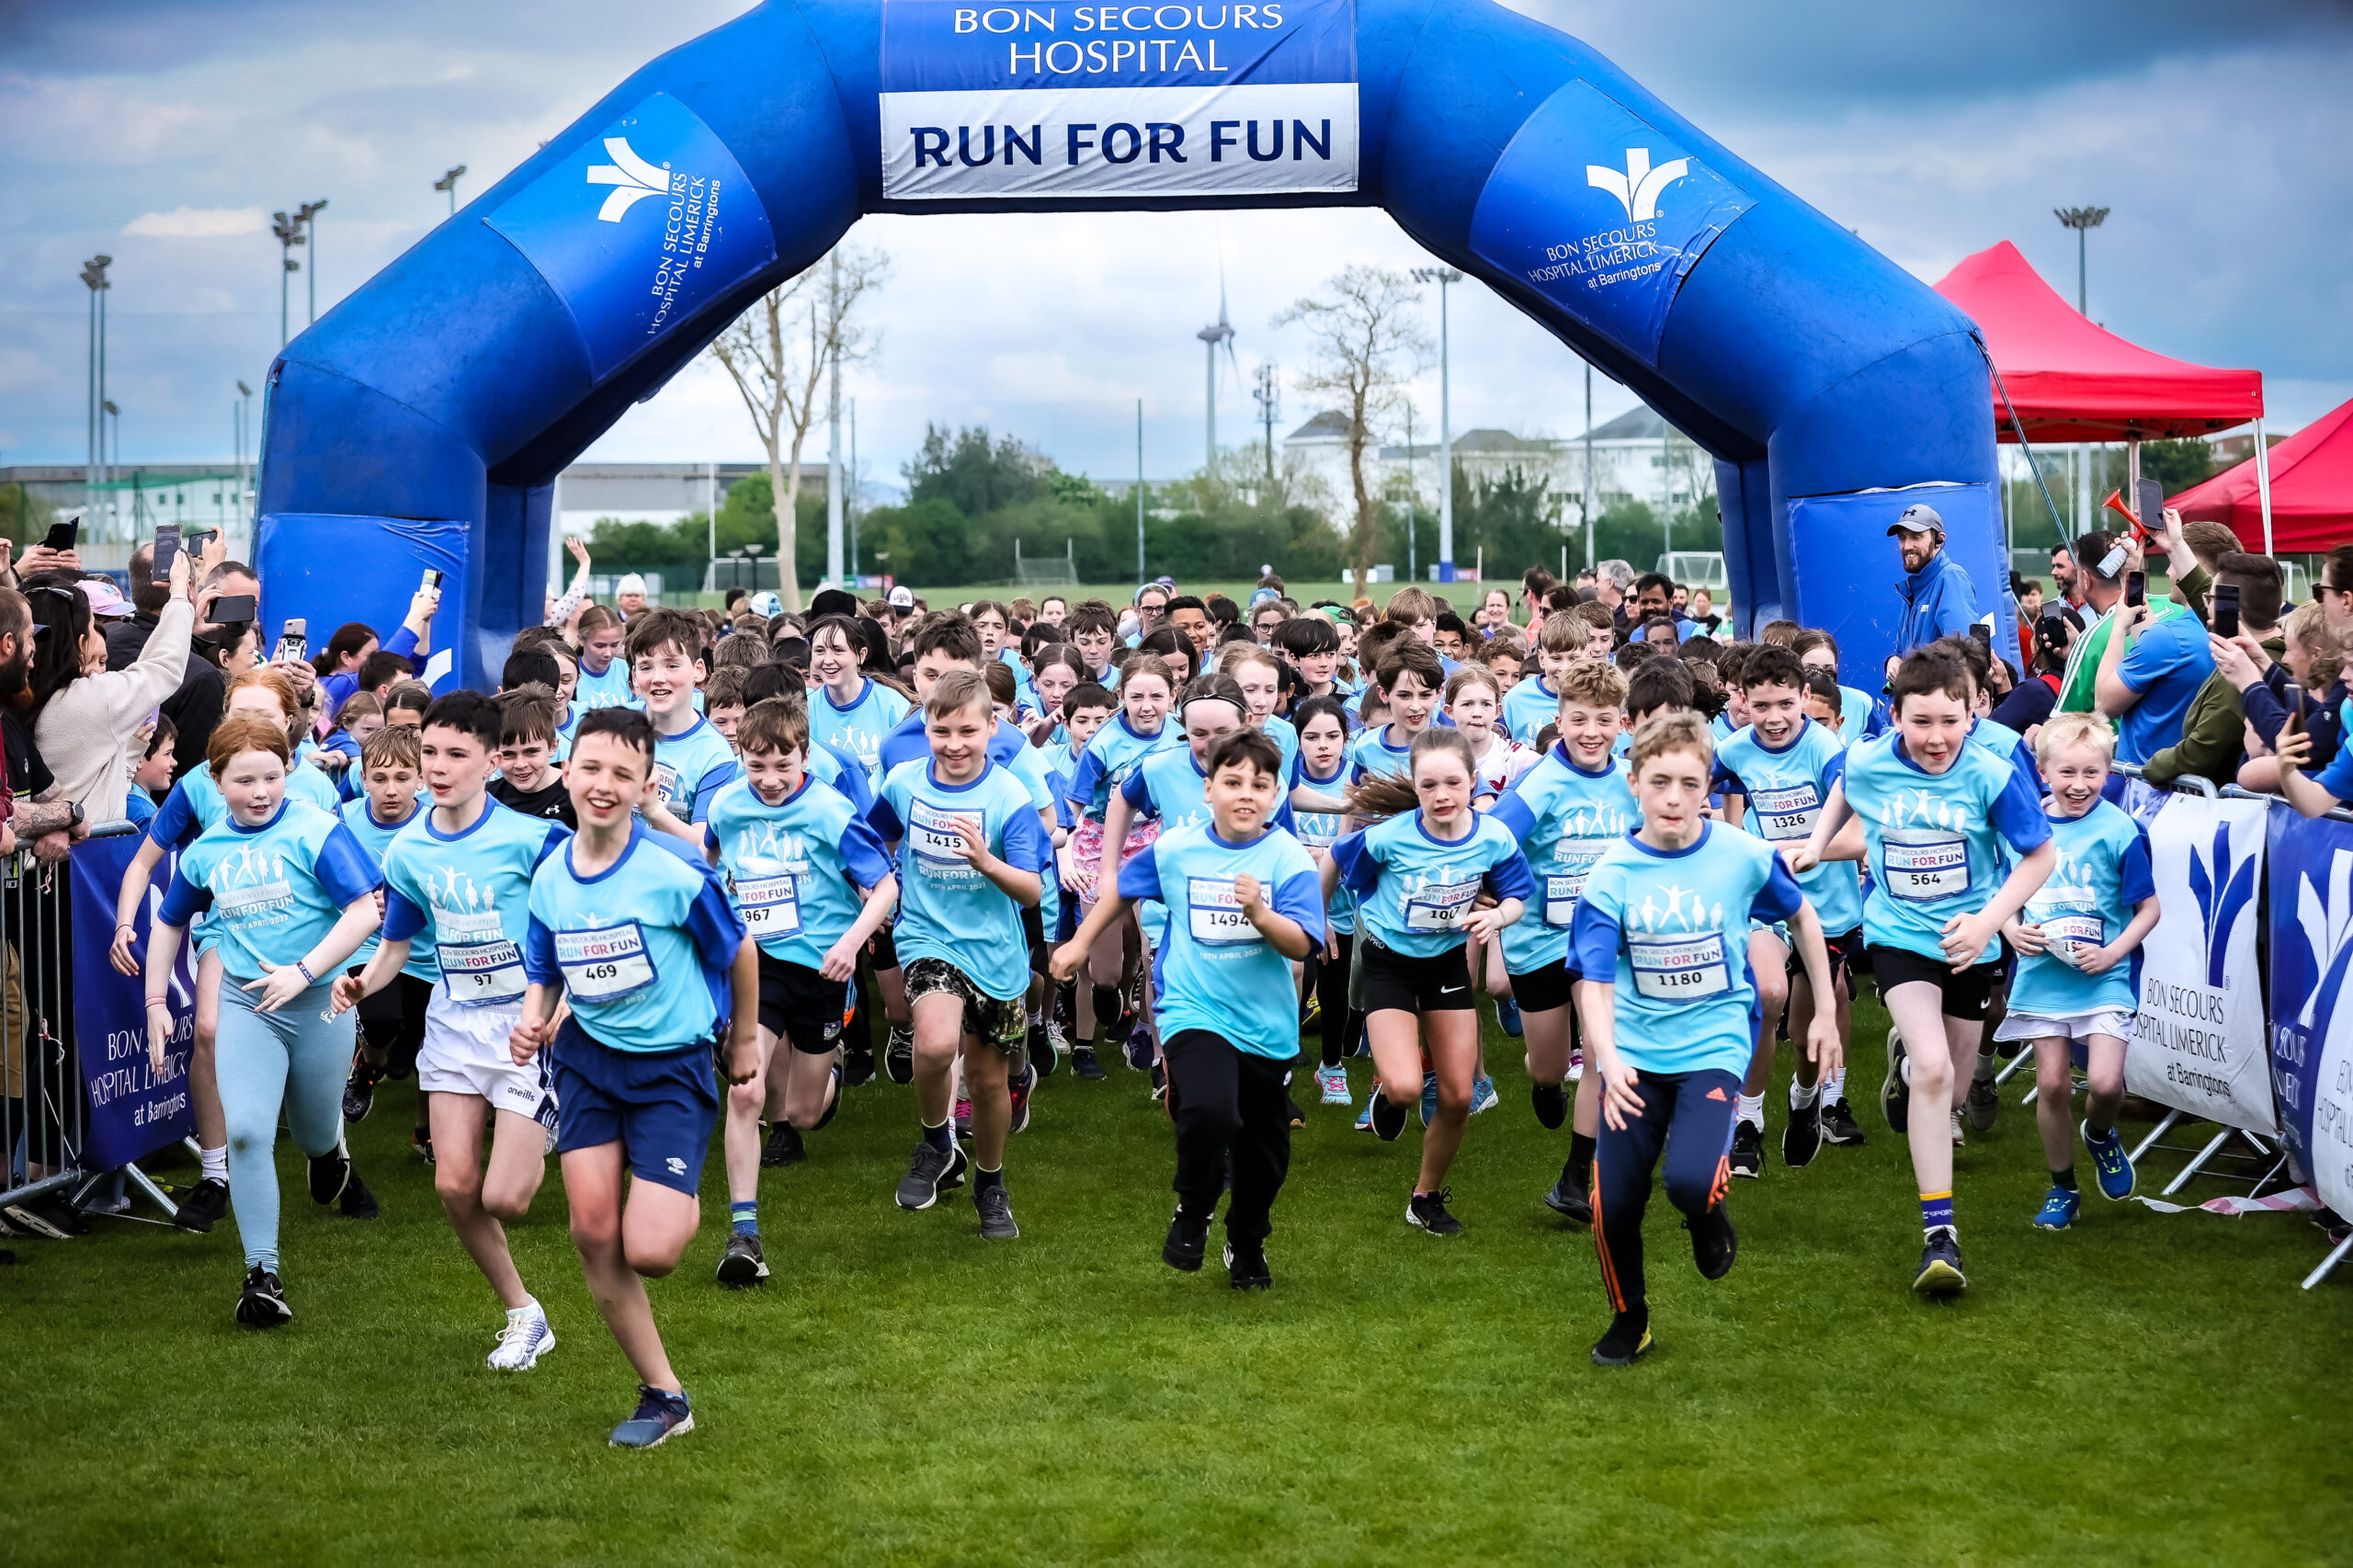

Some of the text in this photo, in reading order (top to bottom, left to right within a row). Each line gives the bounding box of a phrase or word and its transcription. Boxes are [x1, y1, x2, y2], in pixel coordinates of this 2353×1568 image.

[954, 4, 1284, 33] BON SECOURS
[1010, 39, 1229, 74] HOSPITAL
[910, 118, 1331, 167] RUN FOR FUN
[693, 179, 721, 268] at Barringtons
[652, 172, 688, 296] BON SECOURS
[1546, 222, 1656, 262] BON SECOURS
[647, 176, 705, 334] HOSPITAL LIMERICK
[1528, 240, 1659, 283] HOSPITAL LIMERICK
[1587, 262, 1662, 289] at Barringtons
[1785, 788, 1811, 799] HOSPITAL
[1757, 794, 1816, 810] RUN FOR FUN
[913, 811, 931, 825] RUN
[1772, 813, 1806, 828] 1326
[926, 833, 961, 847] 1415
[1553, 852, 1581, 863] RUN
[1888, 852, 1963, 866] RUN FOR FUN
[919, 865, 941, 879] RUN
[941, 869, 968, 880] FOR
[1911, 874, 1940, 886] 564
[760, 879, 790, 890] HOSPITAL
[1550, 887, 1574, 896] RUN
[745, 891, 767, 902] FOR
[767, 887, 792, 899] FUN
[1192, 892, 1216, 903] RUN
[1441, 892, 1461, 904] FOR
[1461, 888, 1478, 899] FUN
[241, 901, 268, 917] FOR
[268, 894, 295, 910] FUN
[2052, 903, 2075, 913] FOR
[231, 914, 289, 932] 29TH APRIL 2023
[745, 909, 770, 922] 967
[1210, 913, 1249, 926] 1494
[449, 928, 471, 942] FOR
[473, 927, 505, 942] FUN
[598, 928, 634, 941] HOSPITAL
[2063, 926, 2084, 934] FOR
[2085, 926, 2100, 937] FUN
[452, 948, 479, 957] SECOURS
[479, 942, 512, 954] HOSPITAL
[558, 937, 640, 959] RUN FOR FUN
[1219, 951, 1243, 960] APRIL
[442, 949, 517, 968] RUN FOR FUN
[1635, 949, 1721, 966] RUN FOR FUN
[473, 973, 492, 986] 97
[585, 964, 617, 980] 469
[1658, 971, 1702, 986] 1180
[2147, 977, 2223, 1025] BON SECOURS
[108, 1028, 142, 1062] BON
[2169, 1023, 2226, 1064] LIMERICK
[2166, 1062, 2232, 1097] at Barringtons
[507, 1086, 536, 1102] oneills
[134, 1104, 145, 1126] at
